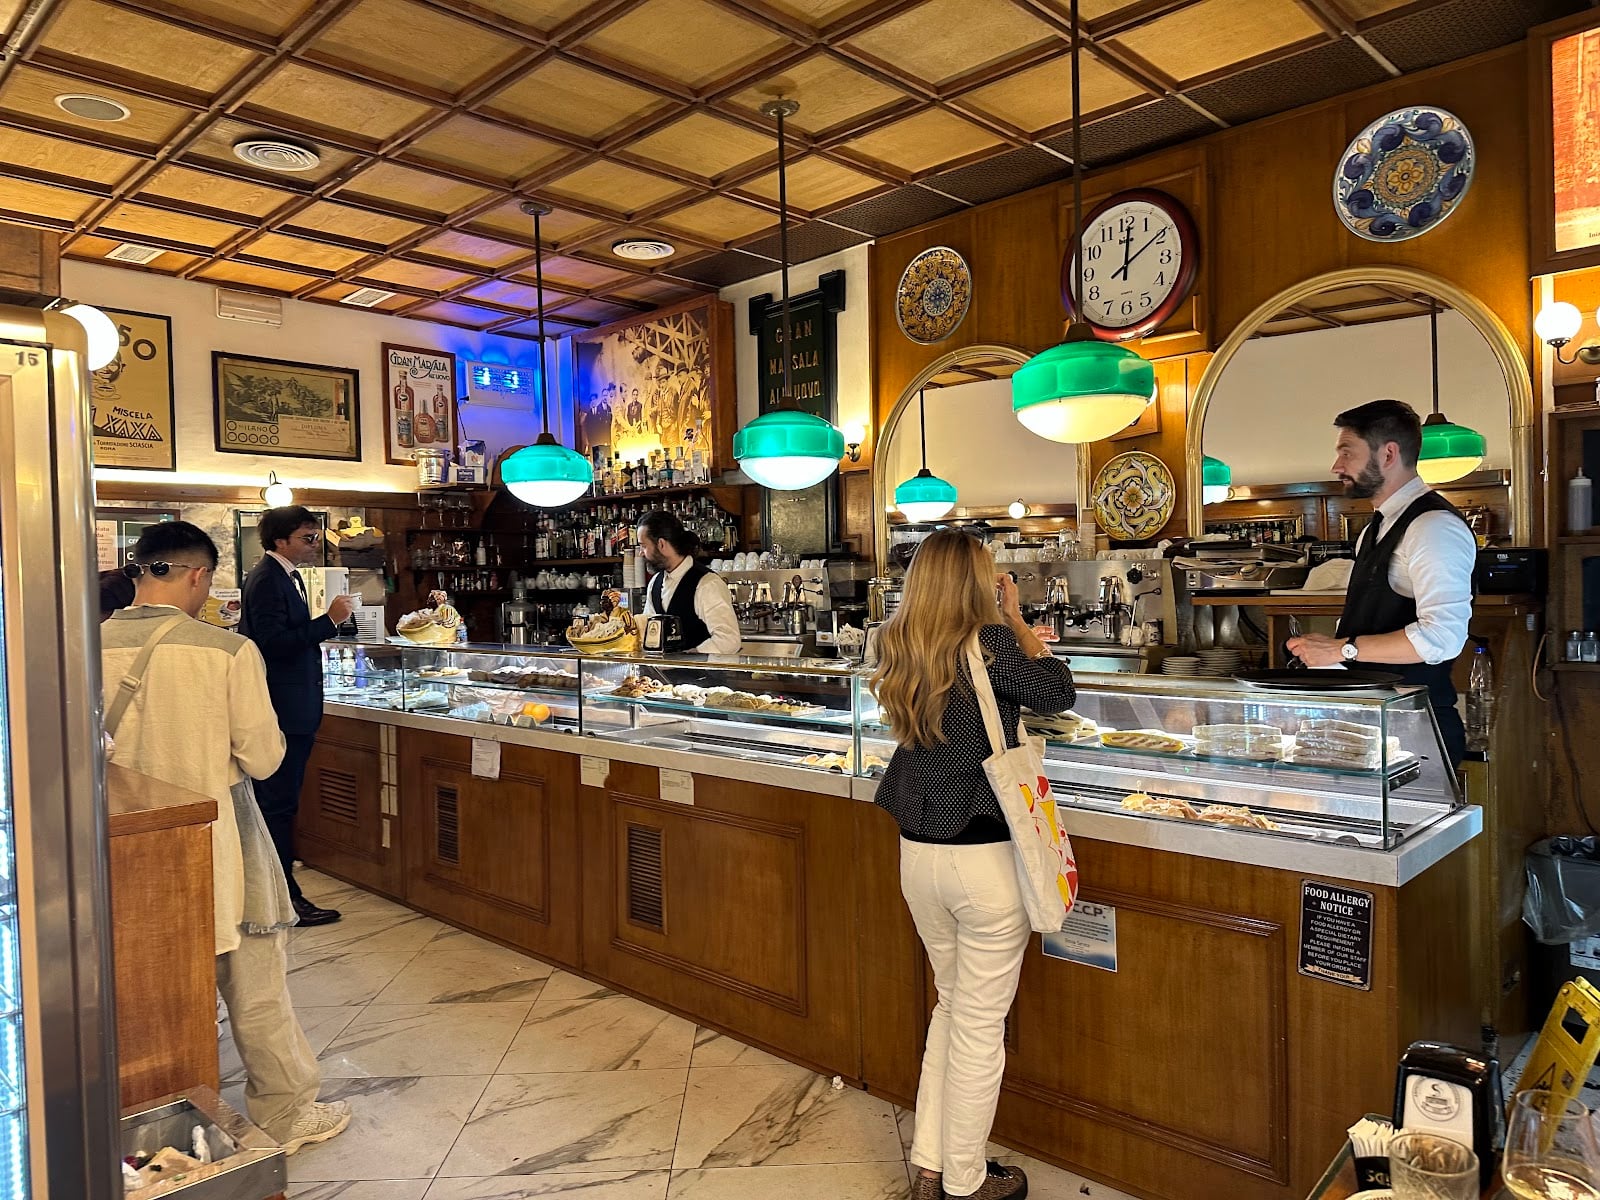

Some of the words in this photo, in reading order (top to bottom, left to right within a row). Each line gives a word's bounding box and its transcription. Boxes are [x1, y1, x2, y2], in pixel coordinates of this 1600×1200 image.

[1119, 216, 1134, 233] 12
[1143, 217, 1149, 232] 1
[1101, 226, 1113, 242] 11
[1155, 229, 1166, 245] 2
[1088, 245, 1102, 261] 10
[1160, 249, 1171, 264] 3
[1084, 268, 1095, 282] 9
[1153, 272, 1164, 286] 4
[1089, 286, 1100, 301] 8
[1140, 292, 1152, 307] 5
[1103, 300, 1114, 315] 7
[1121, 300, 1133, 315] 6
[776, 319, 812, 343] GAN
[16, 351, 39, 367] 15
[769, 351, 819, 375] MASALA
[112, 406, 154, 420] MISCELA
[1305, 886, 1329, 899] FOOD
[1330, 892, 1370, 908] ALLERGY
[1320, 901, 1354, 916] NOTICE
[1310, 919, 1326, 928] FOOD
[1326, 923, 1351, 933] ALLERGY
[1314, 926, 1337, 937] SPECIAL
[1337, 932, 1361, 942] DIETARY
[1316, 933, 1355, 946] REQUIREMENT
[1303, 943, 1326, 953] MEMBER
[1336, 951, 1349, 959] OUR
[1350, 955, 1367, 963] STAFF
[1310, 939, 1331, 949] PLEASE
[1332, 944, 1355, 954] INFORM
[1307, 951, 1330, 961] BEFORE
[1343, 959, 1361, 969] PLACE
[1315, 959, 1331, 967] YOUR
